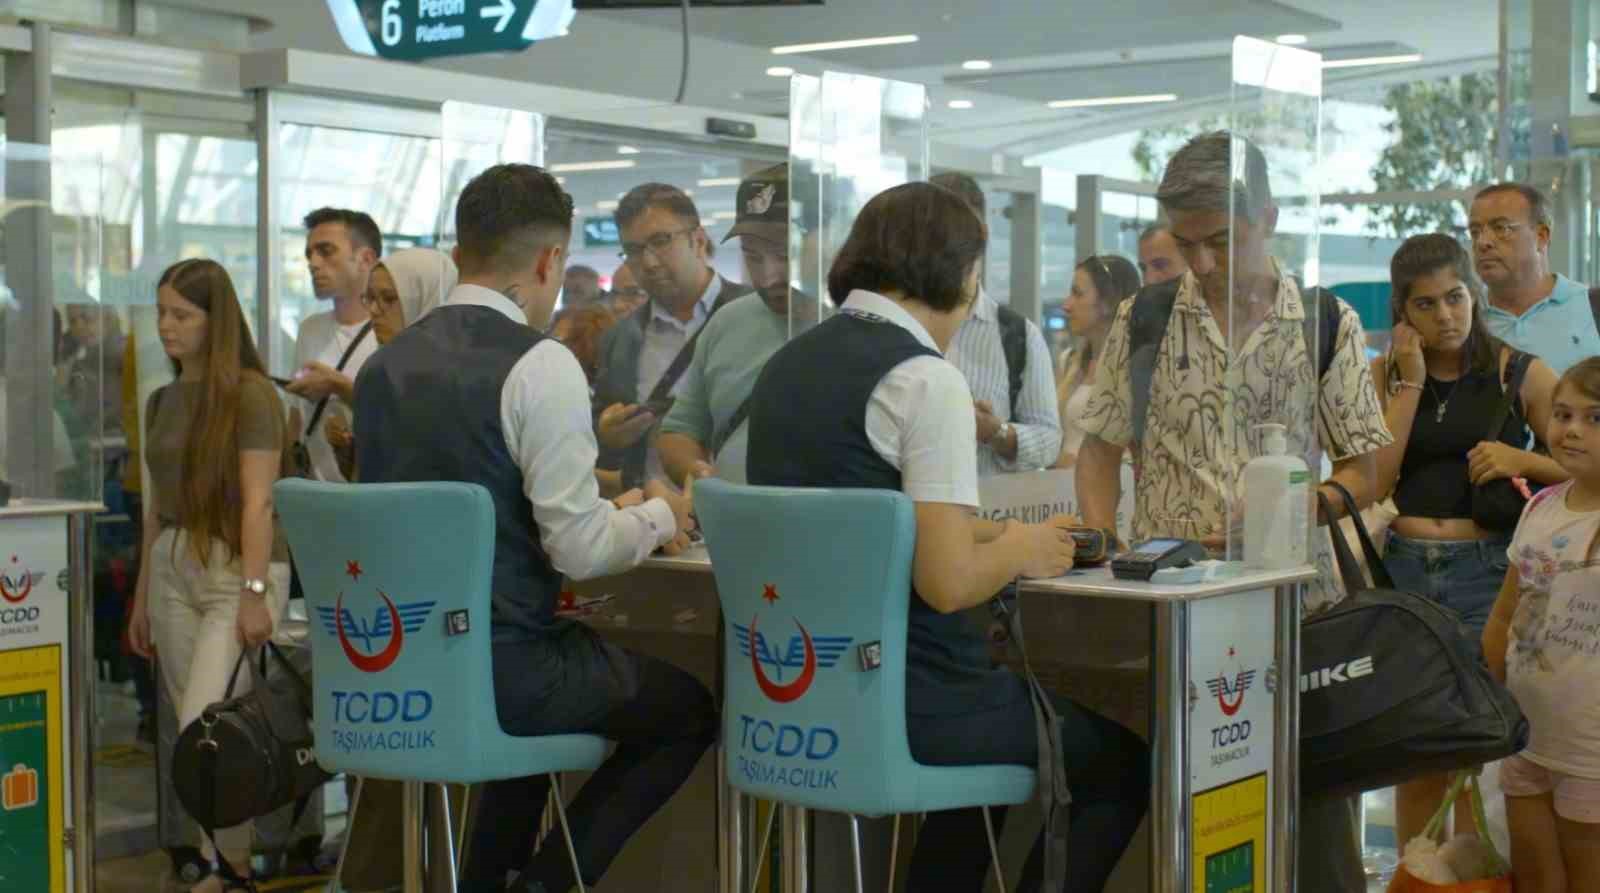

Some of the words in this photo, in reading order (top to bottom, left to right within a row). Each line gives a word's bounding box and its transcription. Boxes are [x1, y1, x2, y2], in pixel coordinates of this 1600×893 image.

[381, 0, 402, 46] 6
[418, 0, 465, 19] Peron
[0, 606, 39, 624] CDD
[331, 690, 432, 723] TCDD
[332, 730, 436, 754] TAŞIMACILIK
[740, 714, 839, 760] TCDD
[1211, 719, 1251, 748] TCDD
